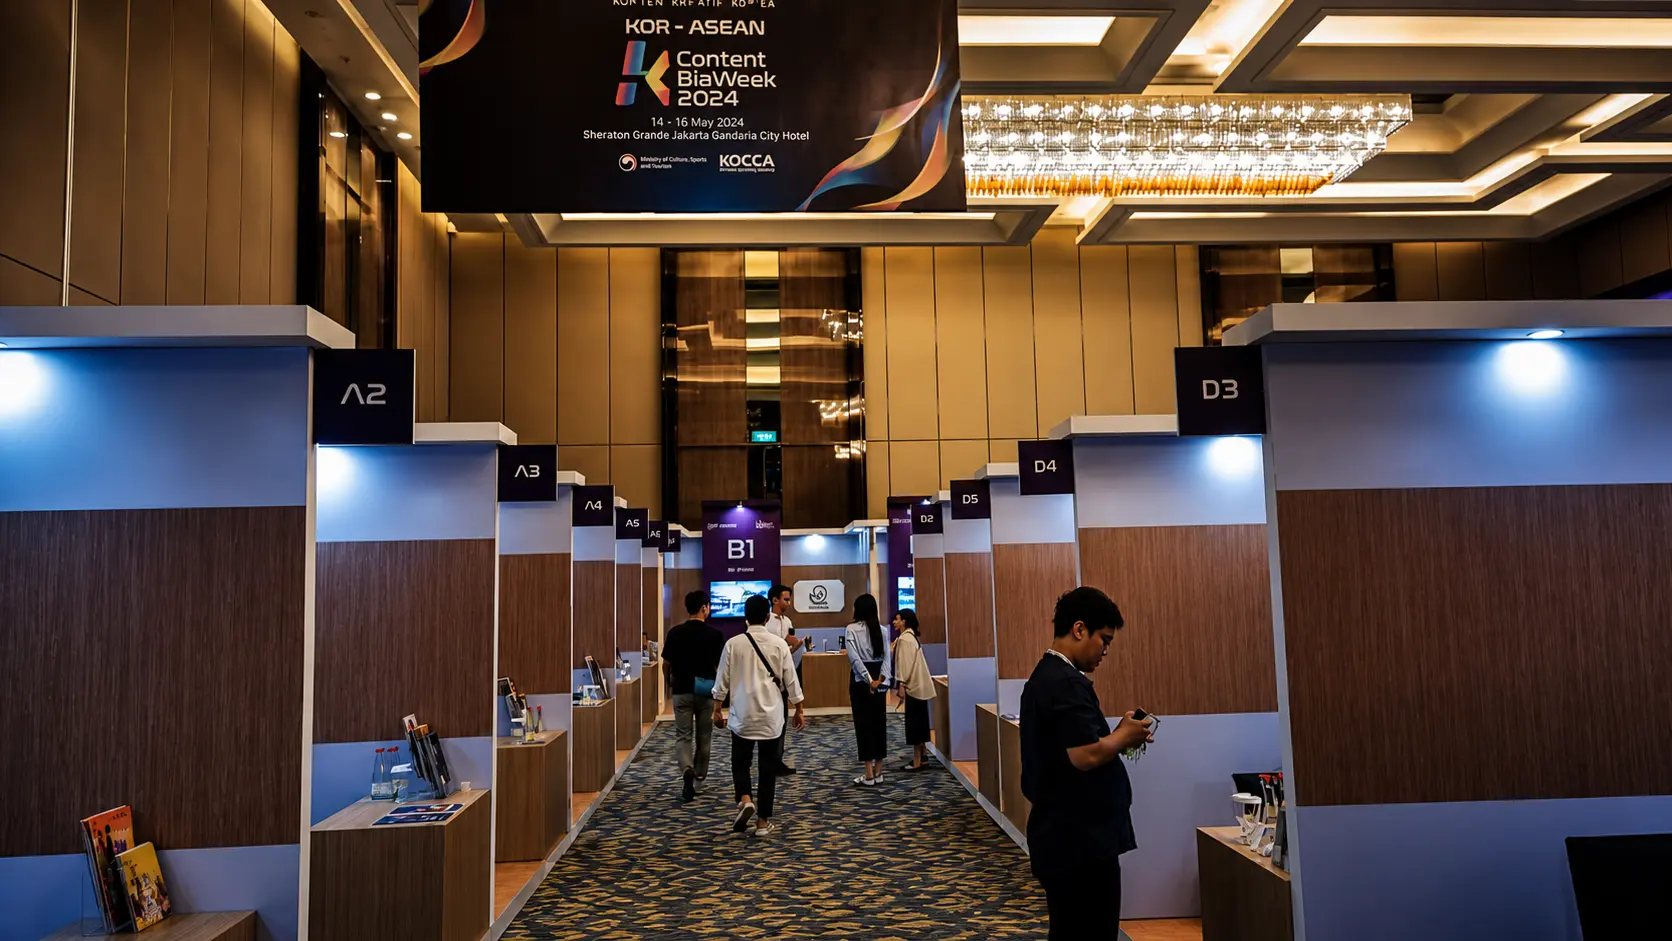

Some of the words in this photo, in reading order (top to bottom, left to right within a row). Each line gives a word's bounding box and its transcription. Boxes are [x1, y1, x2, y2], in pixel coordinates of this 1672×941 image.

[625, 19, 670, 35] KOR
[688, 19, 765, 36] ASEAN
[676, 51, 767, 68] Content
[677, 70, 777, 88] BiaWeek
[677, 90, 740, 107] 2024
[651, 117, 664, 127] 14
[676, 117, 688, 127] 16
[691, 117, 714, 129] May
[716, 117, 745, 128] 2024
[583, 130, 630, 140] Sheraton
[632, 131, 670, 140] Grande
[672, 131, 709, 140] Jakarta
[711, 131, 758, 141] Gandaria
[759, 131, 780, 142] City
[782, 131, 810, 141] Hotel
[719, 154, 776, 167] KOCCA
[340, 382, 387, 405] A2
[1202, 379, 1239, 400] D3
[514, 464, 541, 478] A3
[1034, 459, 1057, 473] D4
[585, 500, 603, 511] A4
[962, 494, 979, 505] D5
[625, 519, 640, 528] A5
[920, 514, 934, 523] D2
[728, 539, 754, 559] B1
